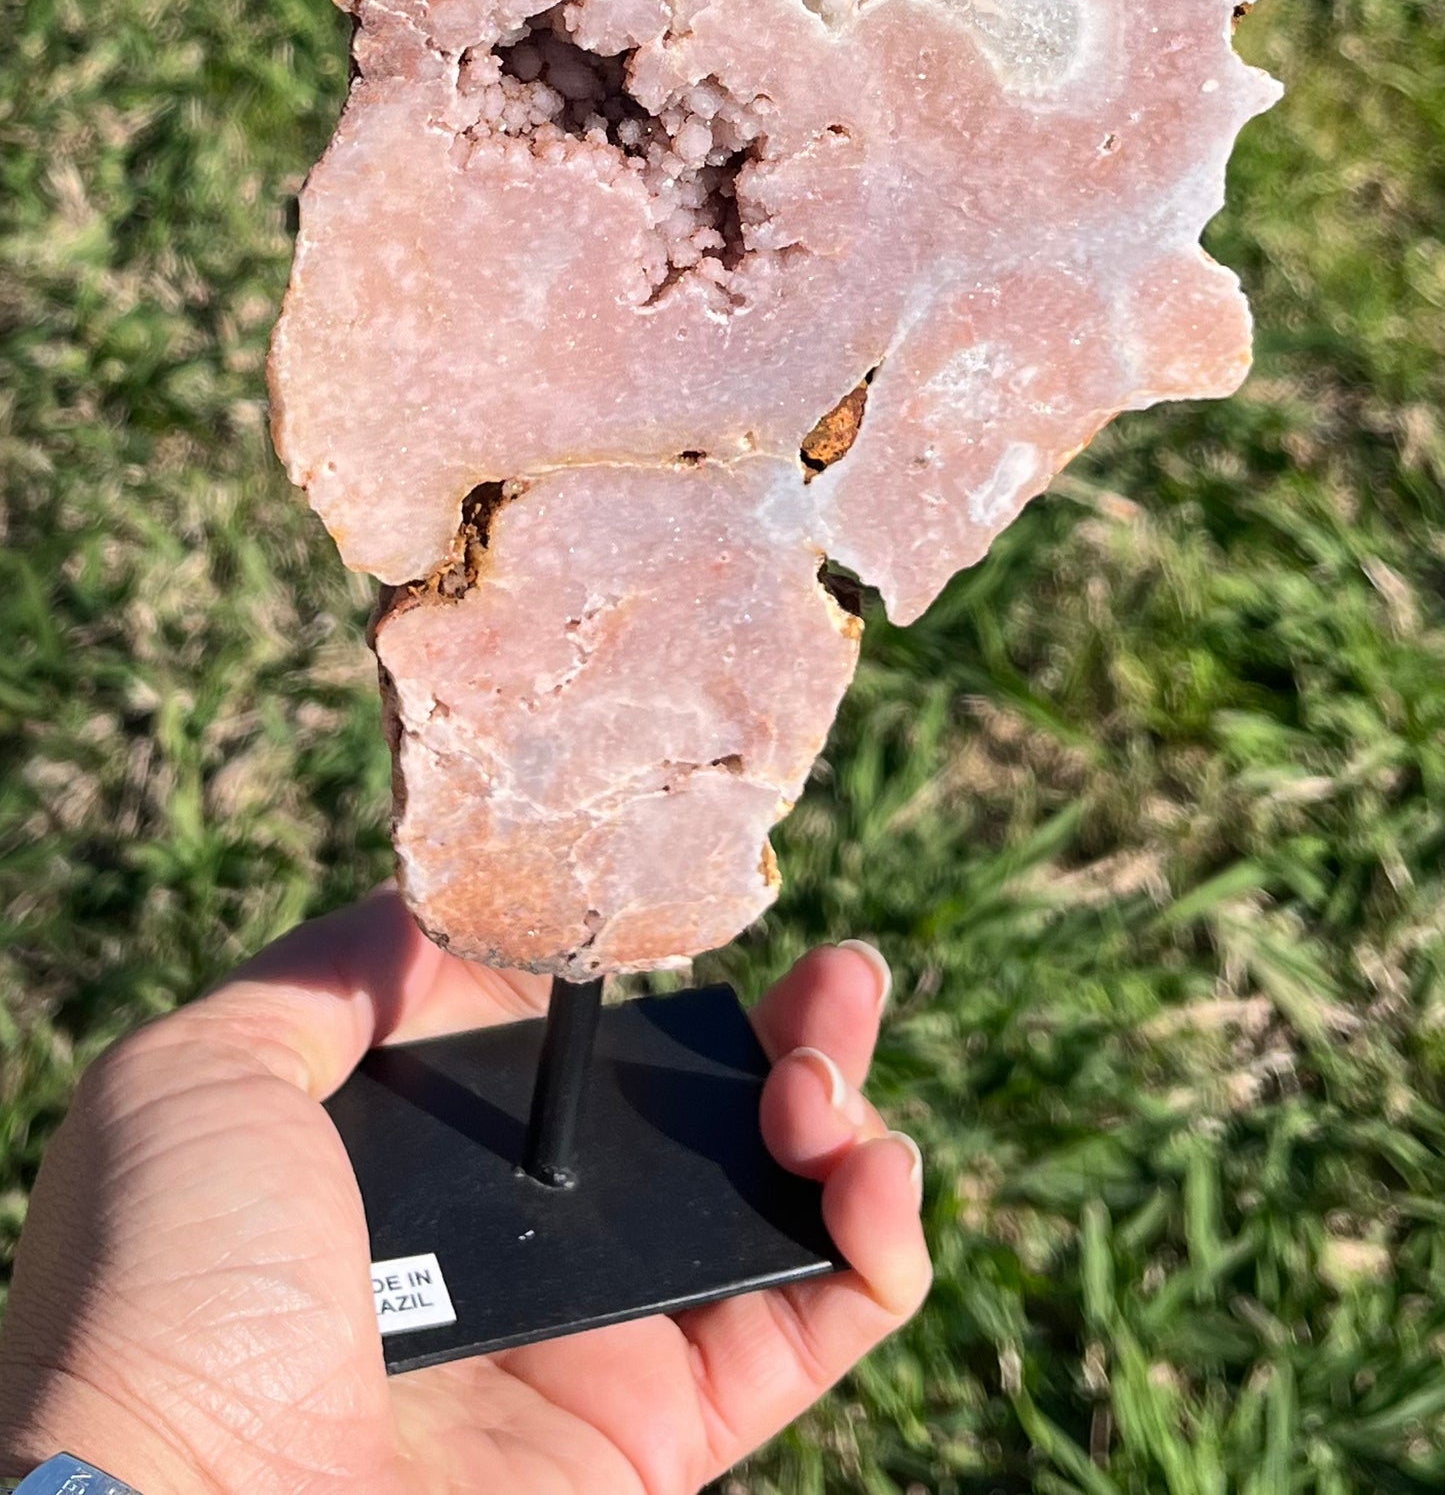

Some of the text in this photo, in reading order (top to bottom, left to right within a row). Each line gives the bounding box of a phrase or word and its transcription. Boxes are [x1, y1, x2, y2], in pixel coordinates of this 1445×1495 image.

[371, 1269, 432, 1293] DE IN
[376, 1292, 434, 1315] AZIL
